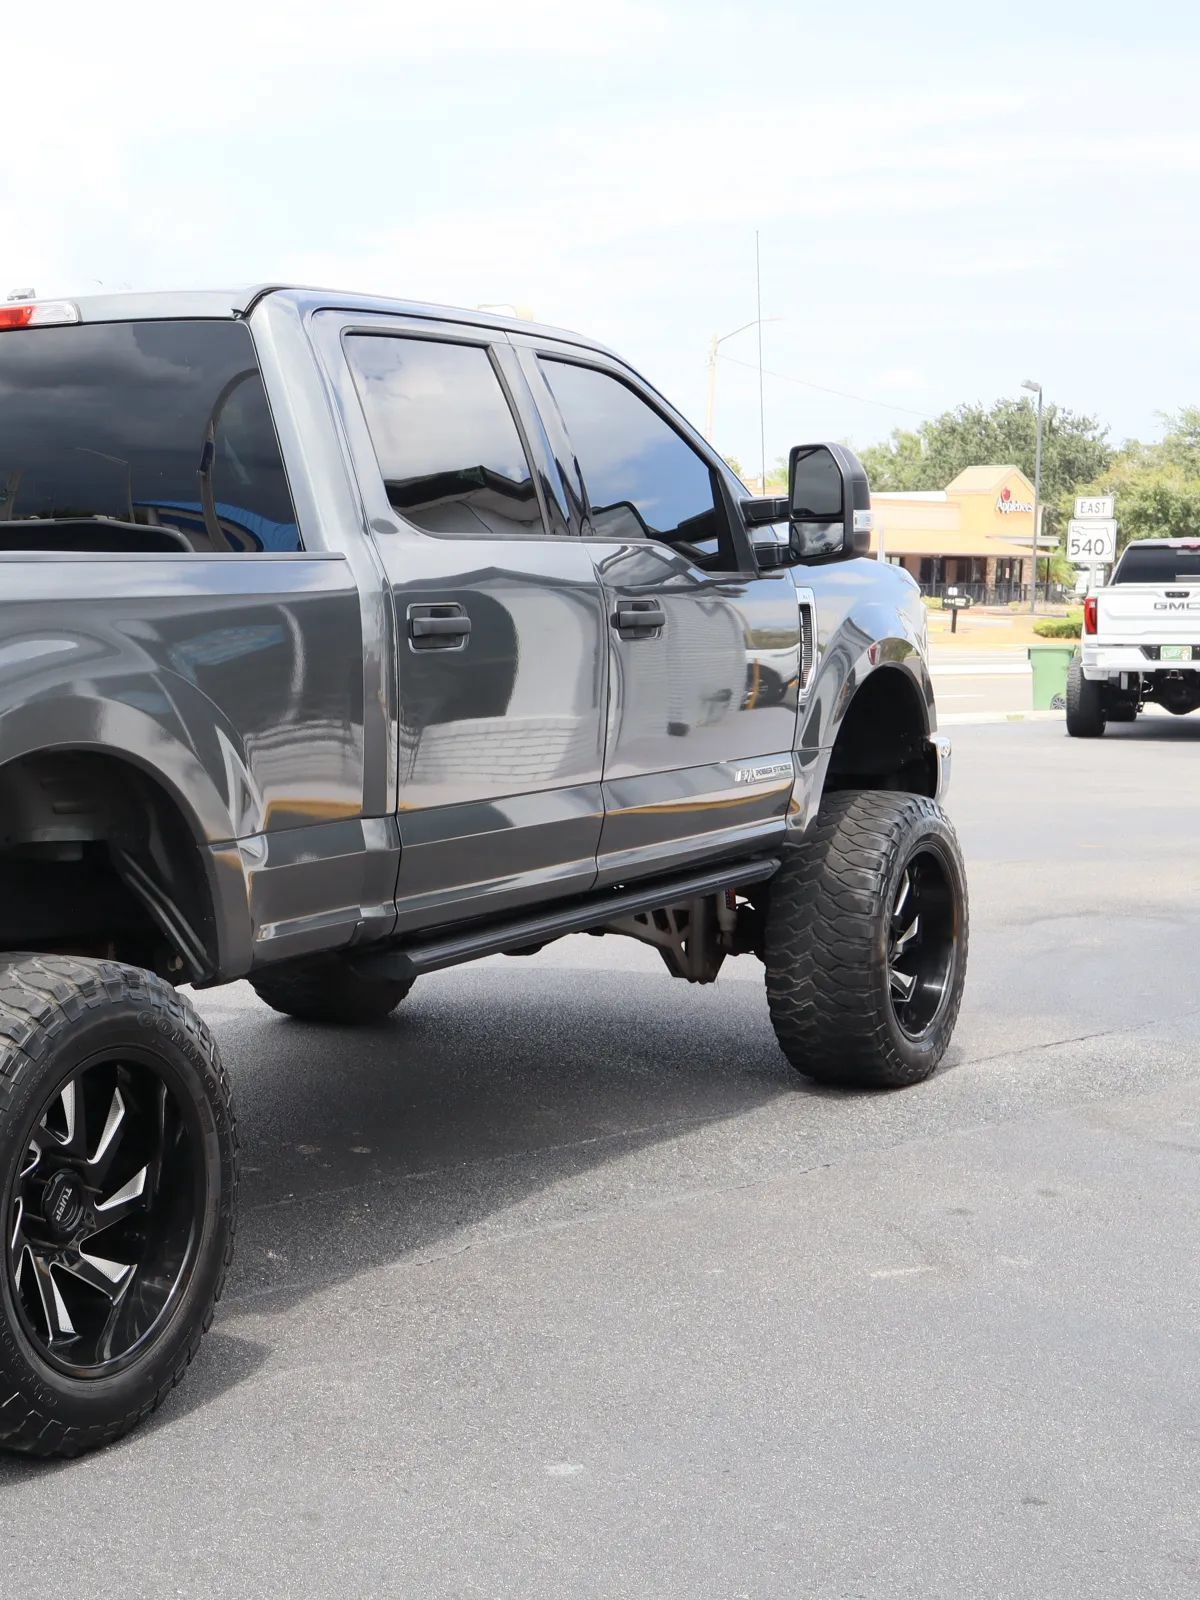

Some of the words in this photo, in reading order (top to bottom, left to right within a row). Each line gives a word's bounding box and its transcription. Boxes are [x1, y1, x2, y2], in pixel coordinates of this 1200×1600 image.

[1080, 501, 1106, 514] EAST
[1071, 539, 1105, 556] 540
[1153, 602, 1200, 610] GMC
